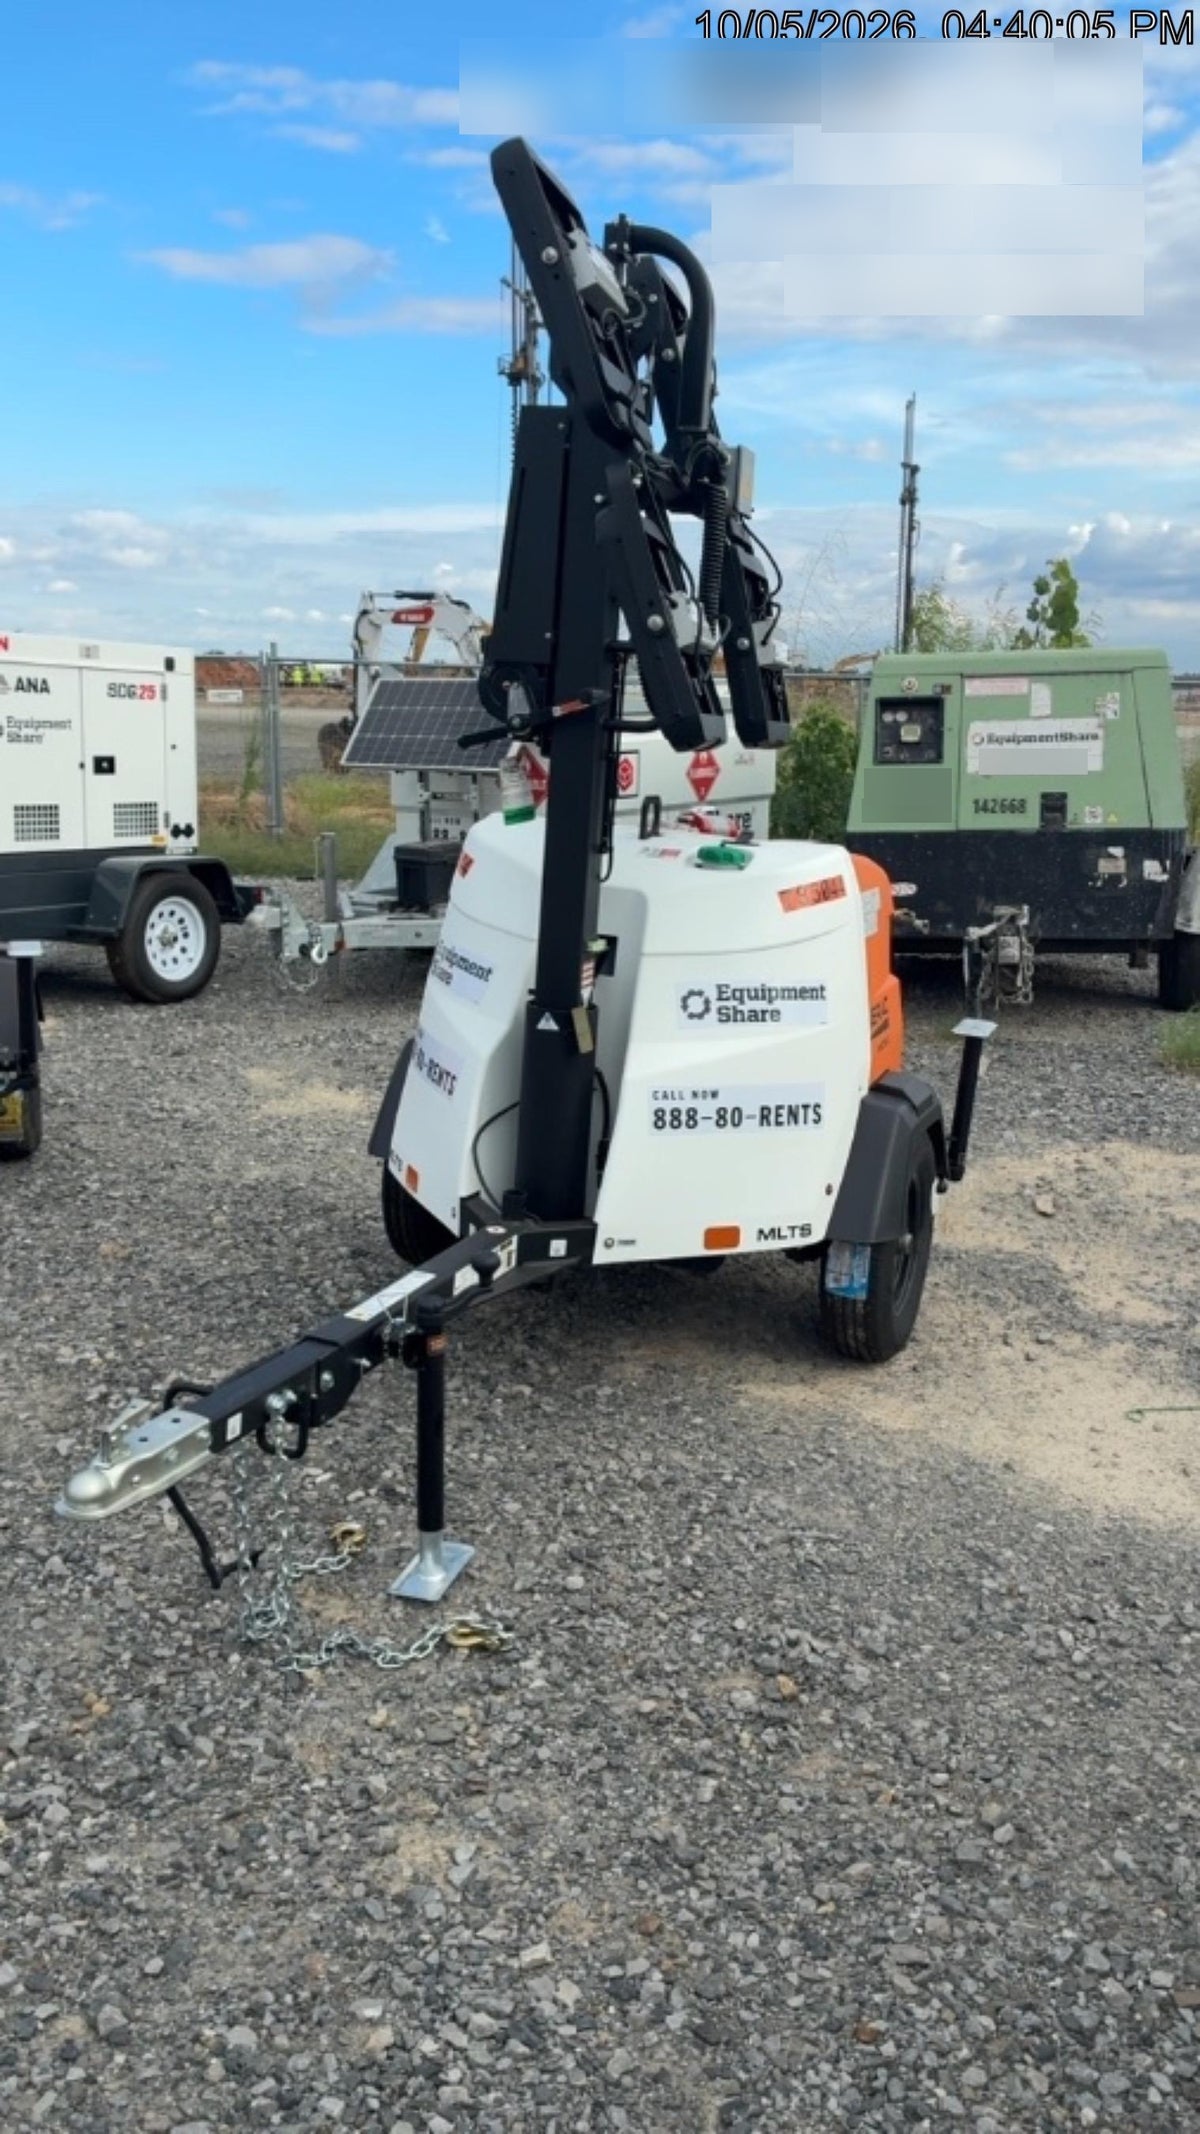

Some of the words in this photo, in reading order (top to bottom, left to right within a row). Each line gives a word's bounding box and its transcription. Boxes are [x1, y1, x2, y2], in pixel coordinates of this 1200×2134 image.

[14, 677, 50, 694] ANA
[6, 715, 72, 732] Equipment
[986, 732, 1099, 745] EquipmentShare
[973, 798, 1027, 815] 142668
[715, 983, 826, 1005] Equipment
[716, 1005, 781, 1023] Share
[652, 1090, 685, 1101] CALL
[691, 1089, 719, 1100] NOW
[653, 1103, 822, 1130] 888-80-RENTS
[757, 1224, 812, 1242] MLTS
